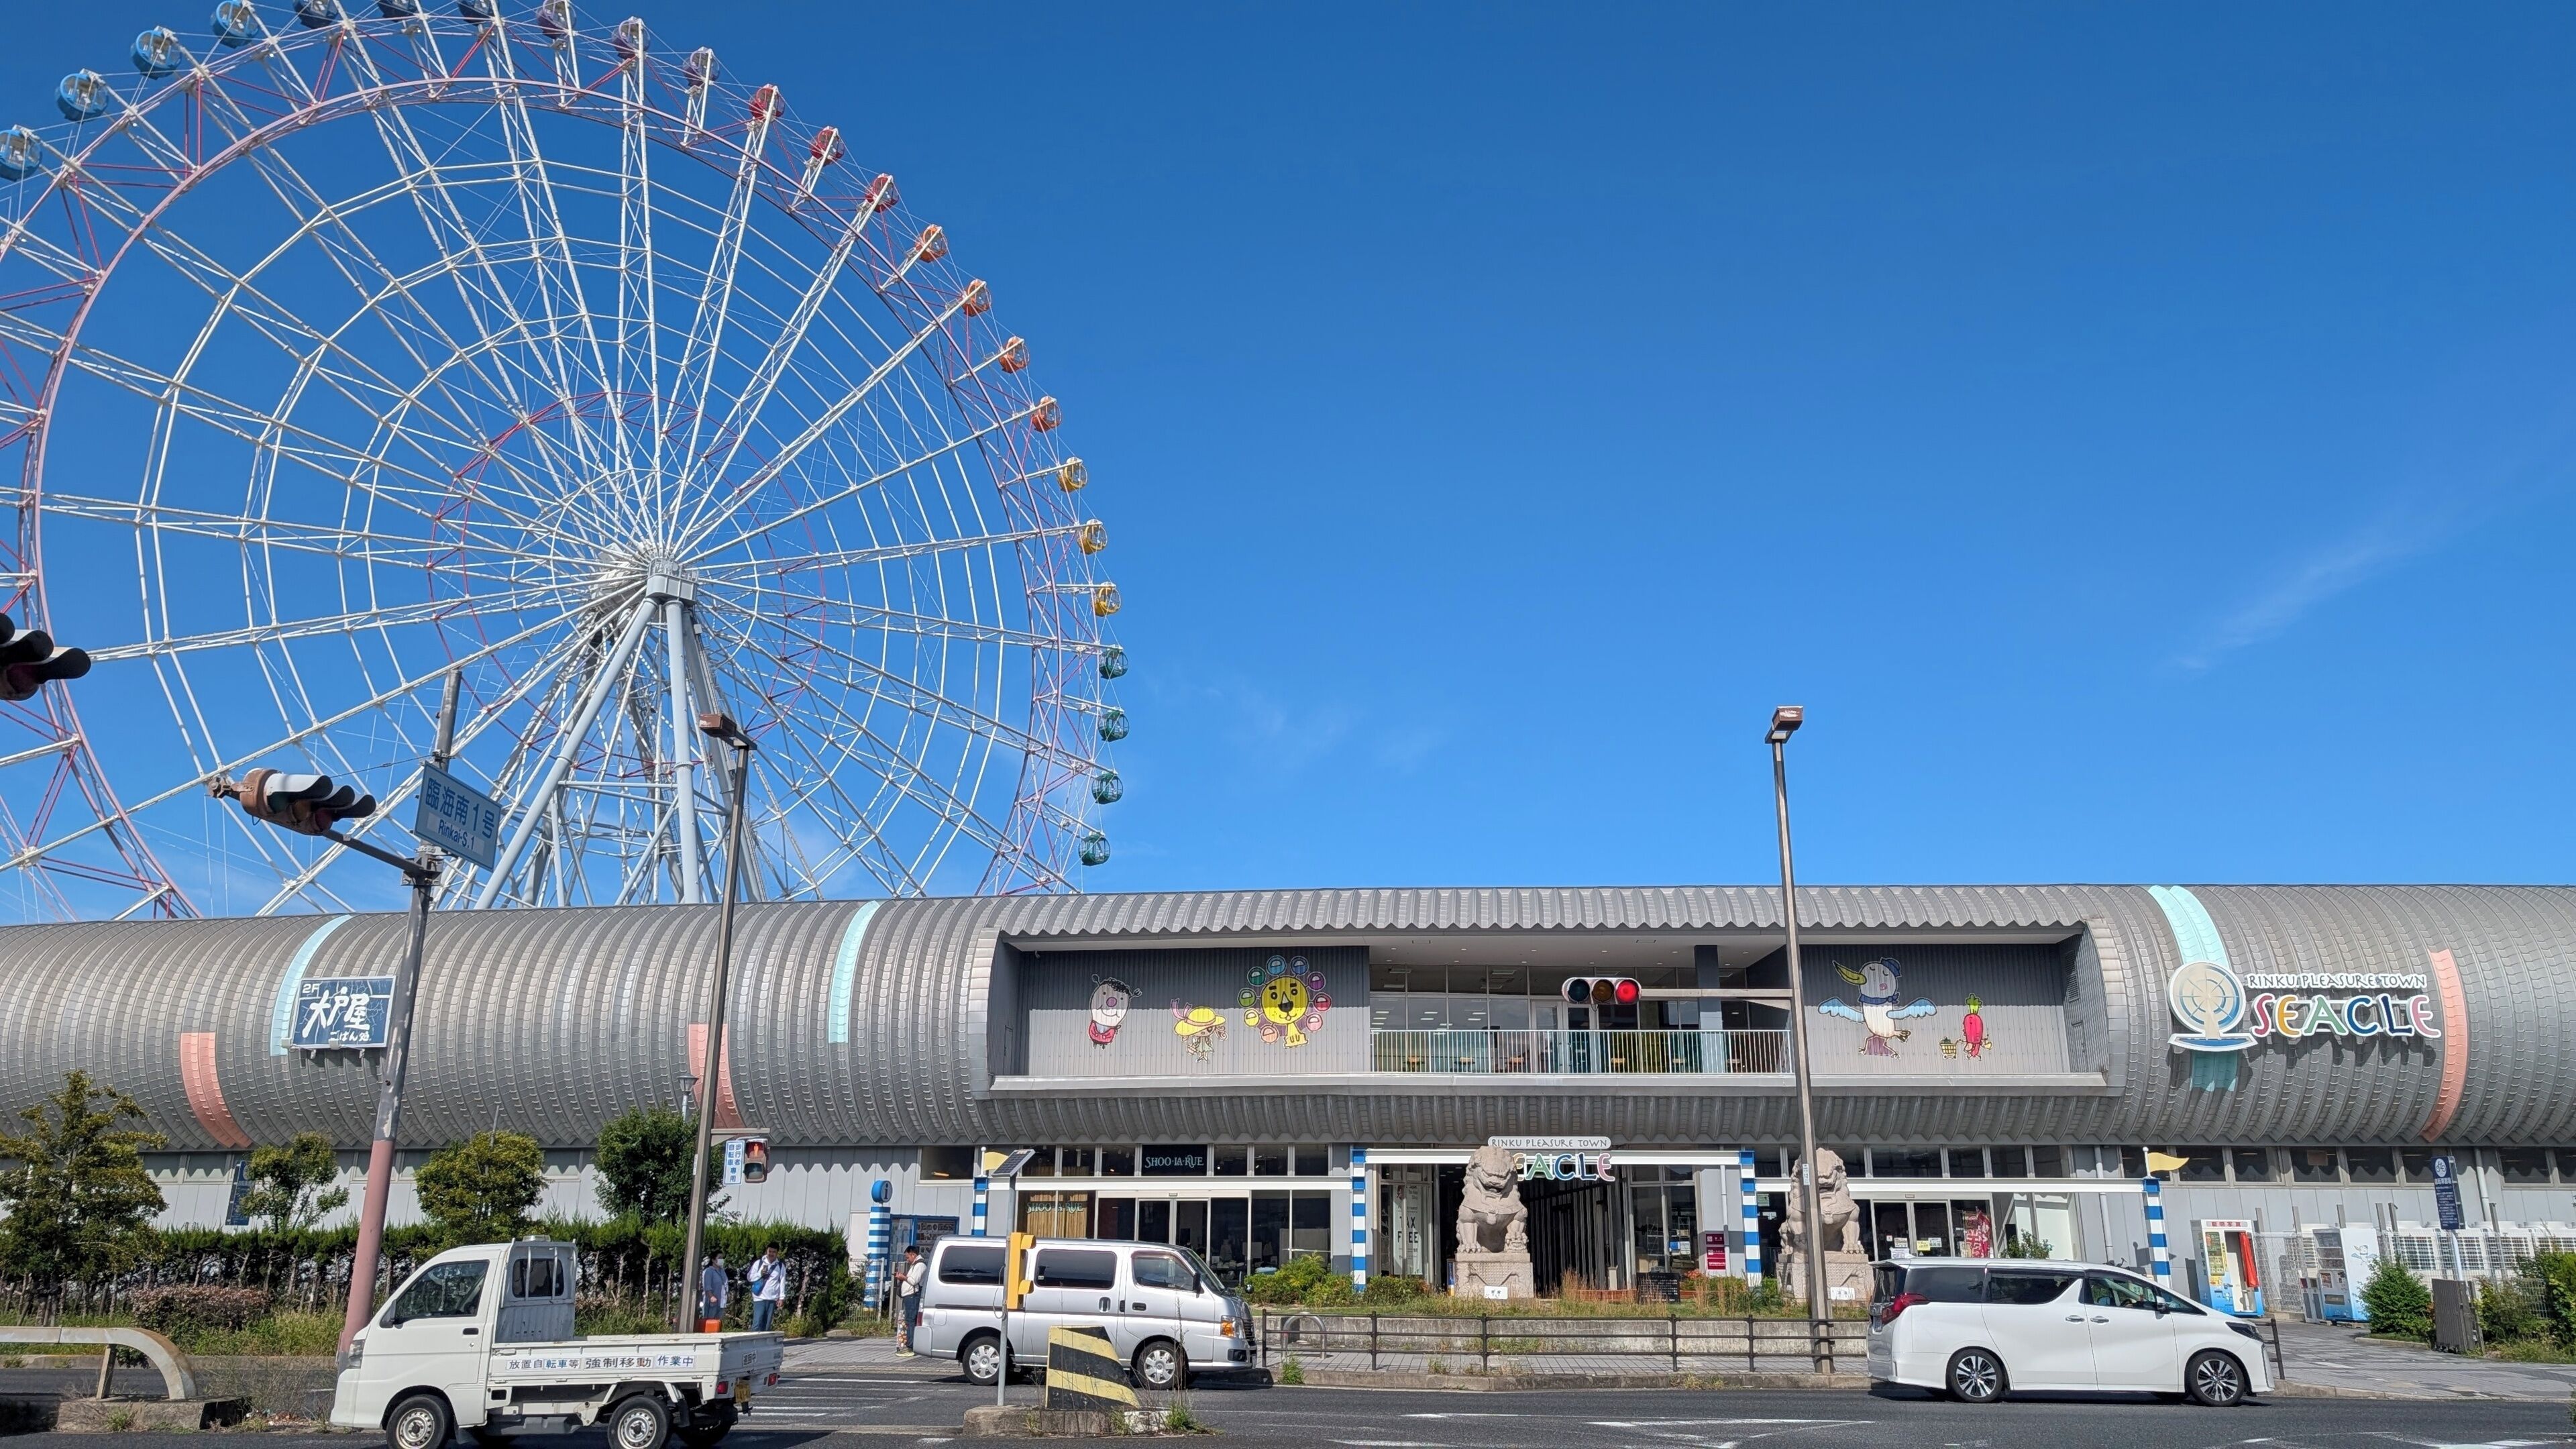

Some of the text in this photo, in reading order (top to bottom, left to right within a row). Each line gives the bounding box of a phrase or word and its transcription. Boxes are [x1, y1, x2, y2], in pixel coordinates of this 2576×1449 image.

[425, 777, 494, 839] 臨海南1号
[438, 819, 475, 850] Rinkai-S.1
[303, 983, 319, 994] 2F
[2248, 974, 2426, 987] RINKU PLEASURE TOWN
[302, 986, 370, 1038] 大戸屋
[2253, 994, 2440, 1037] SEACLE
[1491, 1138, 1607, 1147] RINKU PLEASURE TOWN
[730, 1167, 737, 1182] 専用
[1513, 1152, 1616, 1181] EACLE
[1397, 1230, 1419, 1244] FEE
[509, 1354, 694, 1370] 放置自転車等 強制移動 作業中
